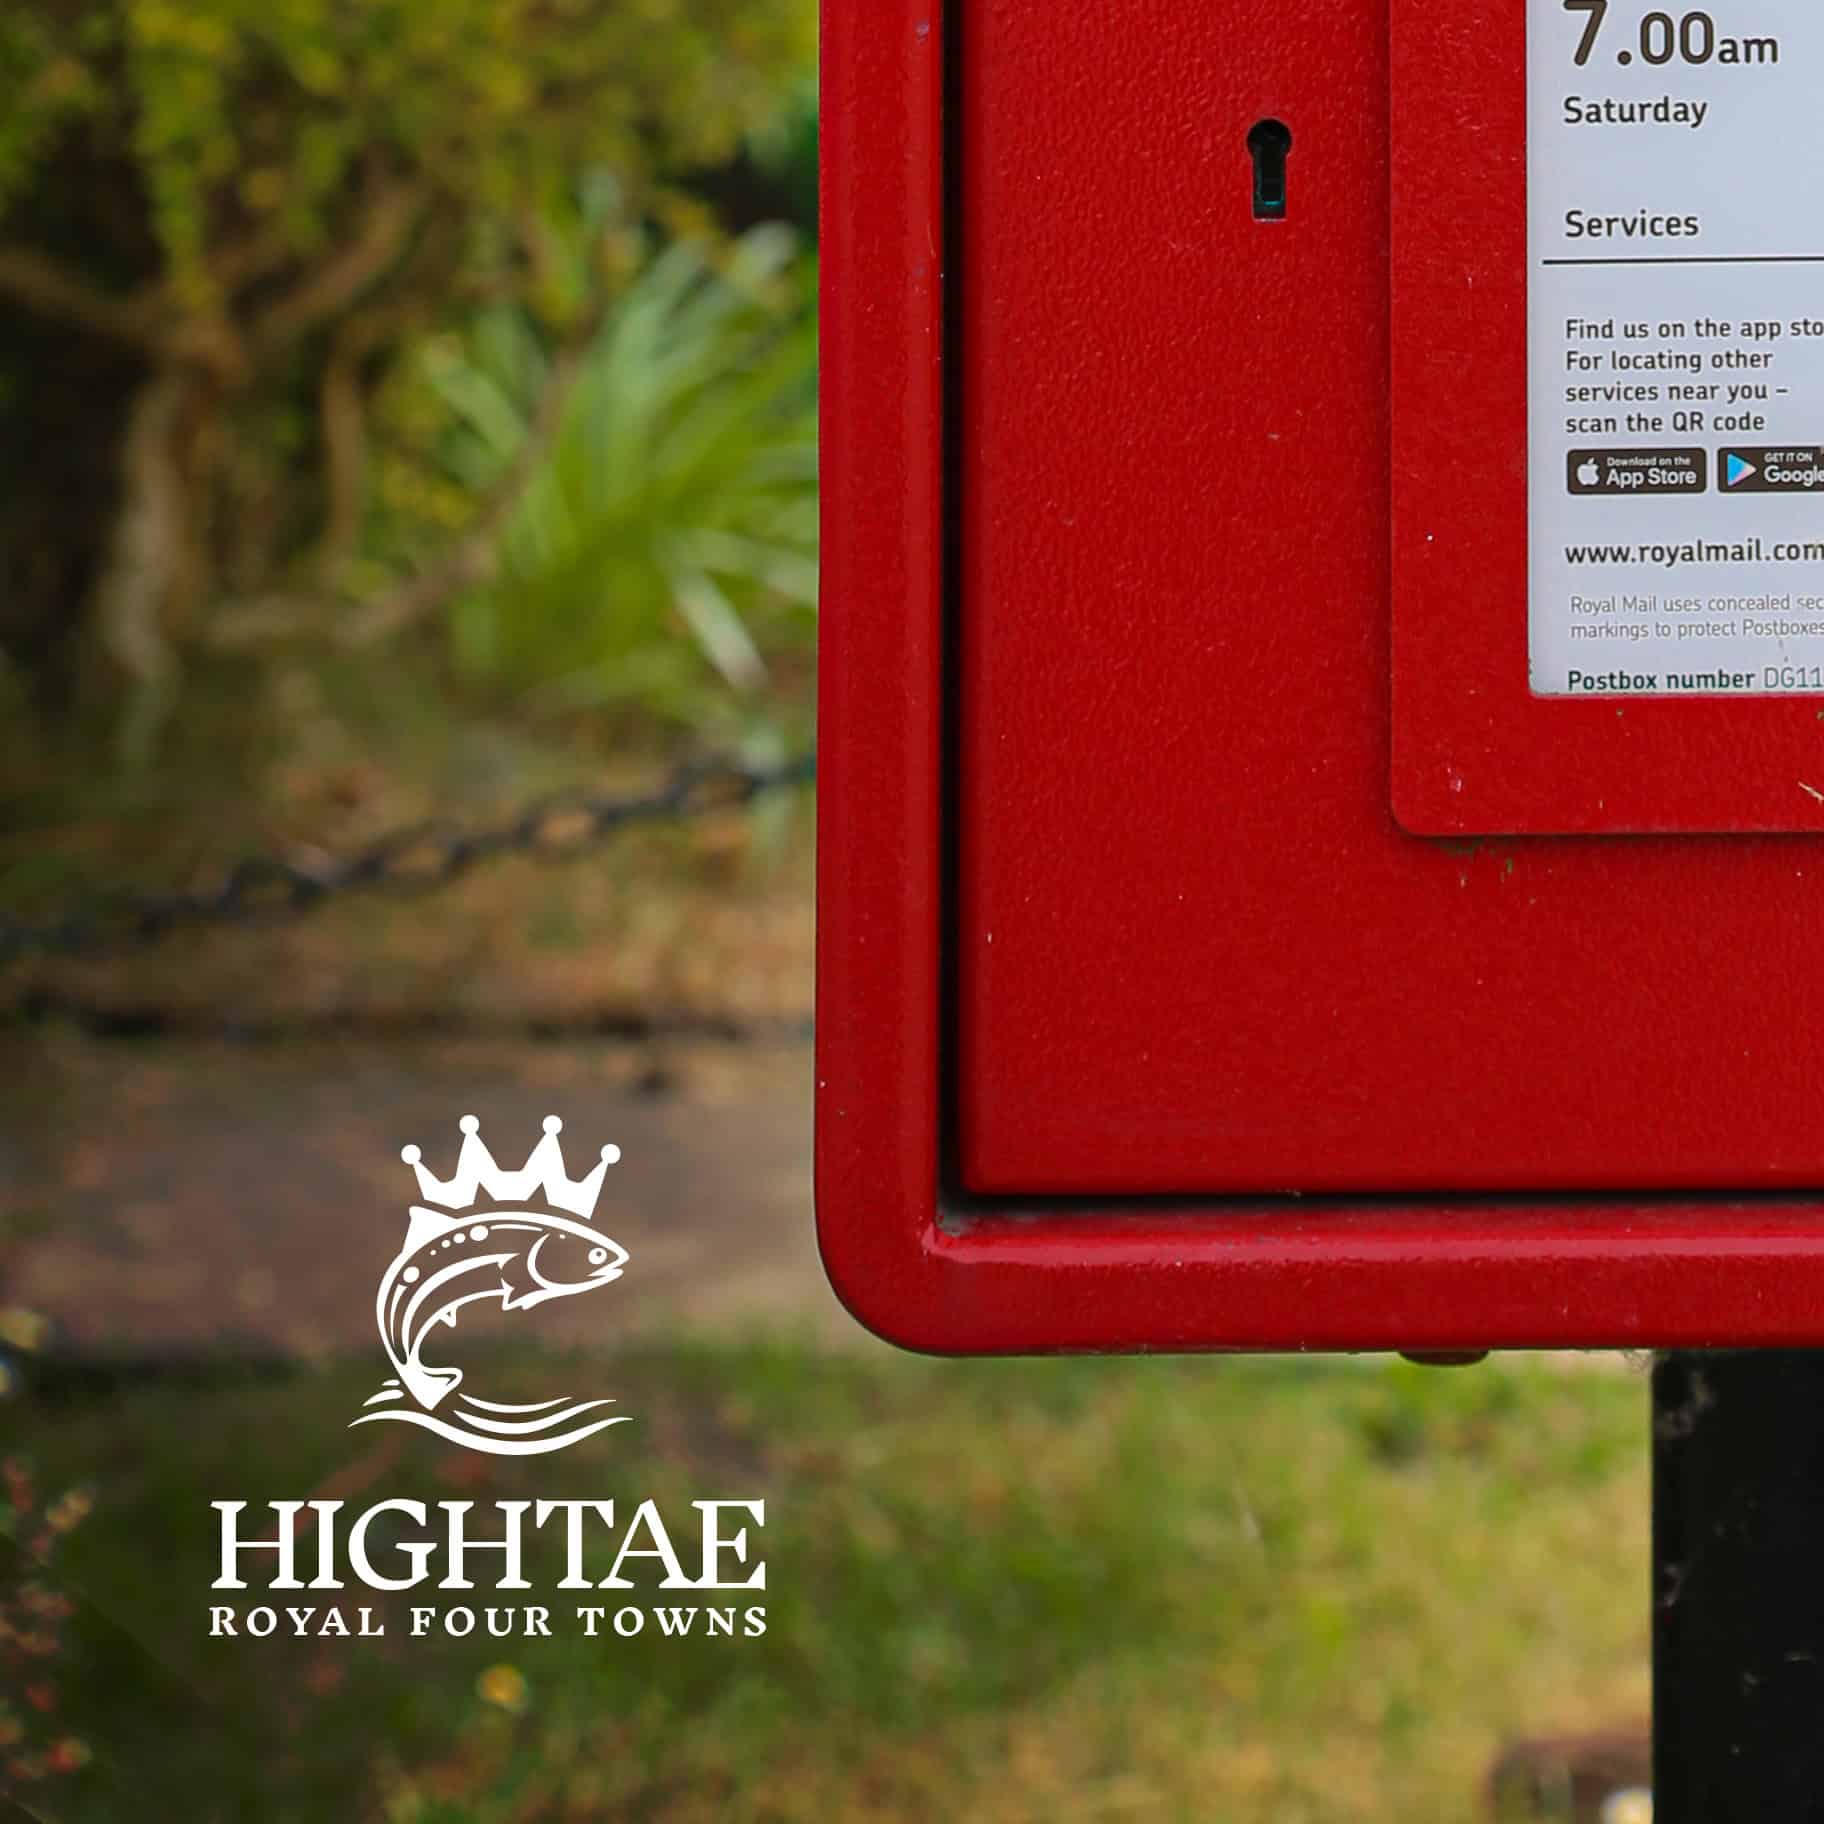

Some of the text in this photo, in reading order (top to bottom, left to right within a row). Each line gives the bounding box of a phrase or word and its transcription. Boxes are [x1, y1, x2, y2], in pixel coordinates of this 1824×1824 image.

[1564, 96, 1707, 128] Saturday
[1566, 209, 1698, 237] Services
[1567, 319, 1613, 338] Find
[1624, 324, 1648, 338] us
[1659, 323, 1684, 337] on
[1694, 318, 1730, 337] the
[1741, 323, 1781, 341] app
[1567, 349, 1772, 373] For locating other
[1566, 382, 1658, 401] services
[1668, 386, 1719, 400] near
[1728, 385, 1767, 404] you
[1567, 412, 1764, 433] scan the QR code
[1607, 456, 1690, 466] Download on the
[1765, 453, 1813, 463] GET IT ON
[1606, 468, 1696, 488] App Store
[1565, 538, 1824, 567] www.royalmail.com
[1571, 596, 1616, 614] Royal
[1622, 595, 1657, 612] Mail
[1664, 597, 1700, 612] uses
[1708, 595, 1791, 610] concealed
[1571, 620, 1648, 640] markings
[1655, 621, 1669, 637] to
[1678, 620, 1737, 640] protect
[1568, 669, 1659, 692] Postbox
[1666, 669, 1755, 689] number
[1764, 667, 1824, 690] DG11
